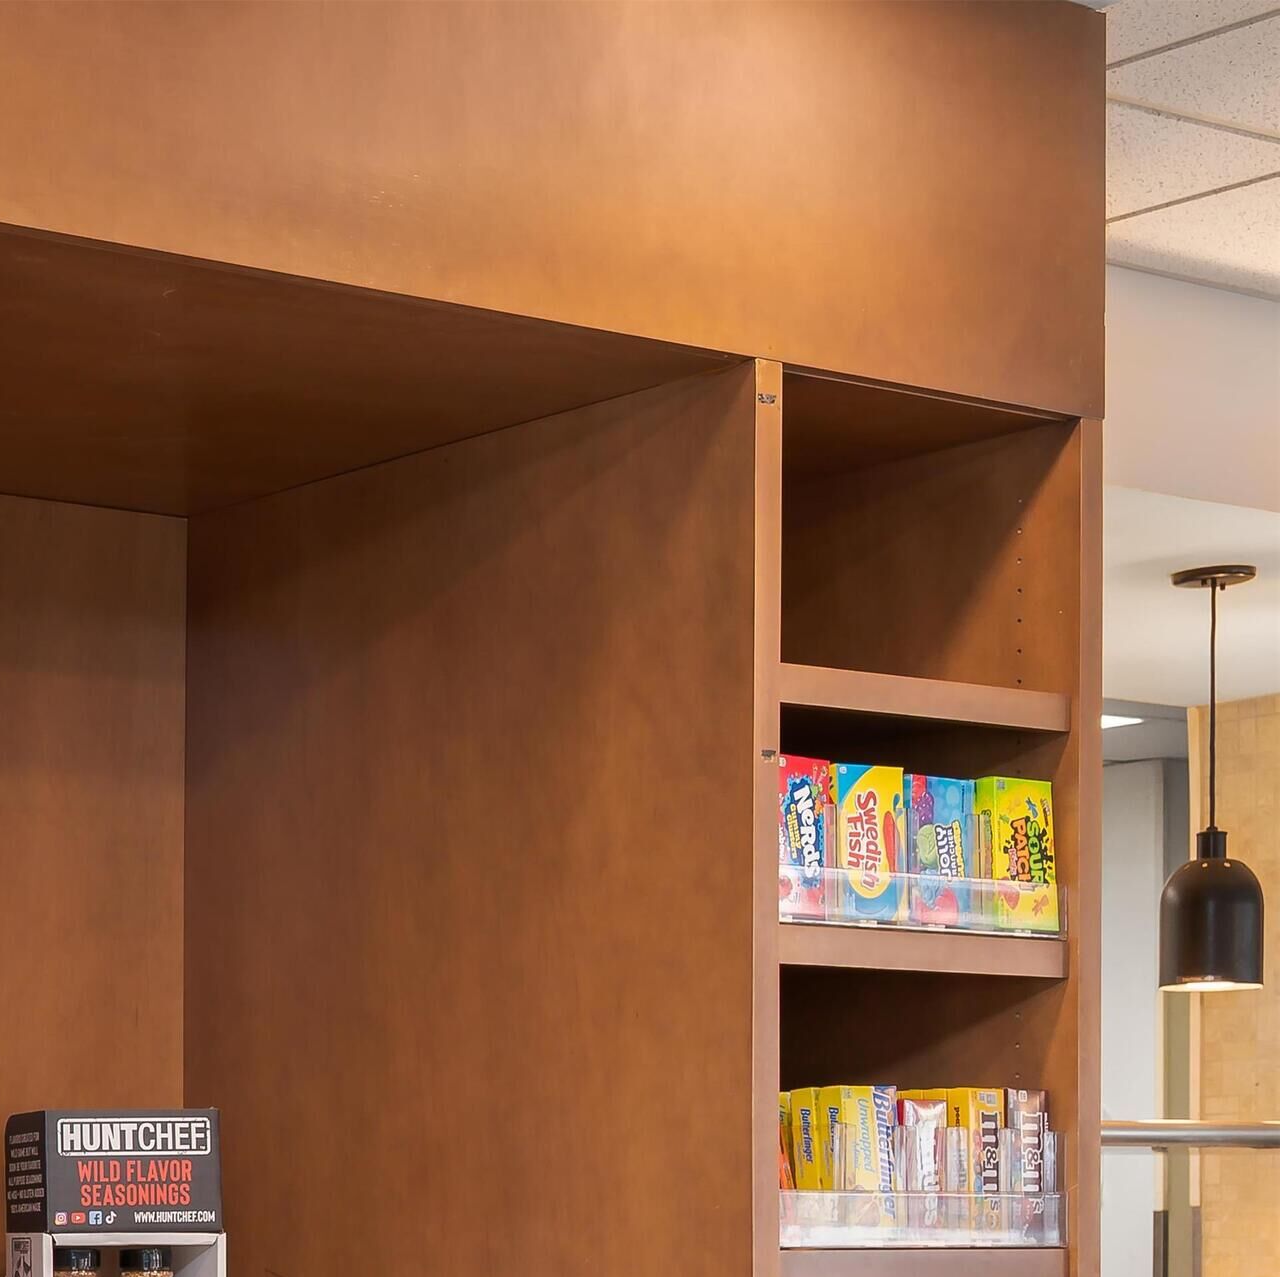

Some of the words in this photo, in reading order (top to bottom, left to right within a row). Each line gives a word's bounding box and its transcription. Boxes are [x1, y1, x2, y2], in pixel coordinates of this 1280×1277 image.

[847, 813, 865, 868] Fish
[857, 790, 881, 888] Swedish
[935, 827, 952, 880] JOLLY
[947, 829, 958, 876] RANCHER
[1027, 821, 1044, 883] SOUR
[62, 1123, 206, 1151] HUNTCHEF
[800, 1109, 814, 1163] Butterfinger
[857, 1098, 875, 1173] Unwrapped
[872, 1086, 896, 1219] Butterfinger
[78, 1160, 120, 1182] WILD
[126, 1160, 192, 1182] FLAVOR
[80, 1184, 191, 1207] SEASONINGS
[134, 1211, 216, 1223] WWW.HUNTCHEF.COM
